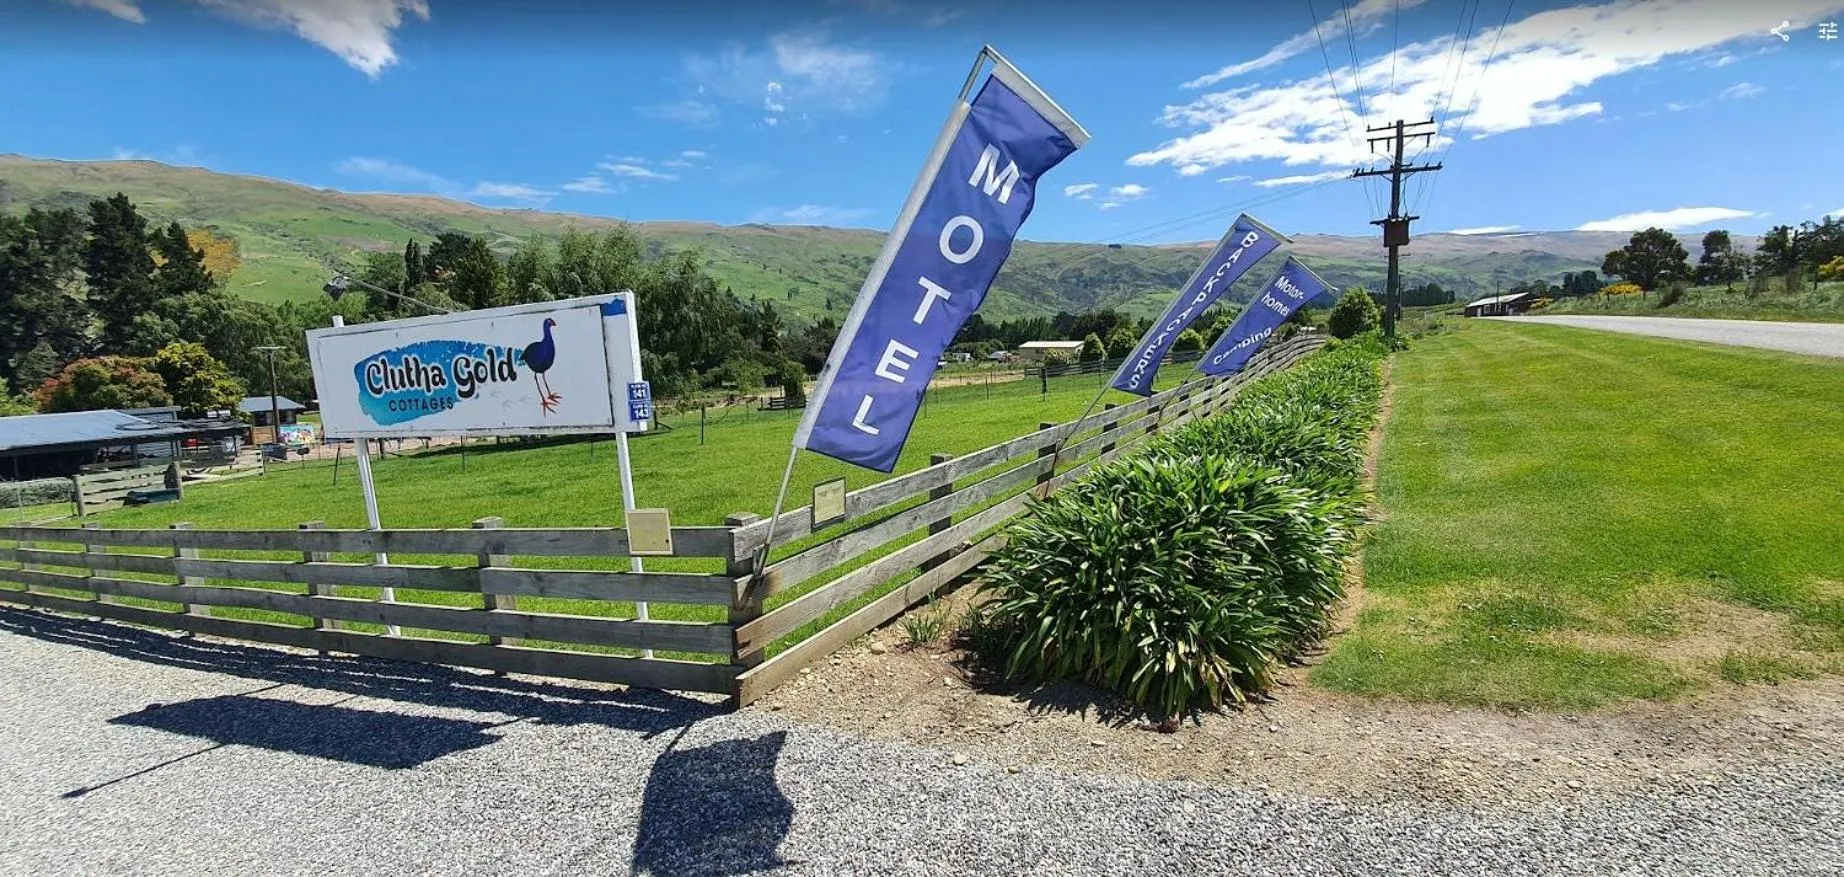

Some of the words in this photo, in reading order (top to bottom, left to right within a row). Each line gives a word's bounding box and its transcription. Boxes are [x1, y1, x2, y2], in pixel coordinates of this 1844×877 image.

[852, 143, 1020, 436] MOTEL
[1128, 231, 1259, 389] BACKPACKERS
[1261, 291, 1291, 317] homes
[1213, 327, 1272, 365] Cping
[366, 356, 447, 395] Clutha
[453, 347, 517, 398] Gold
[388, 396, 454, 412] COTTAGES
